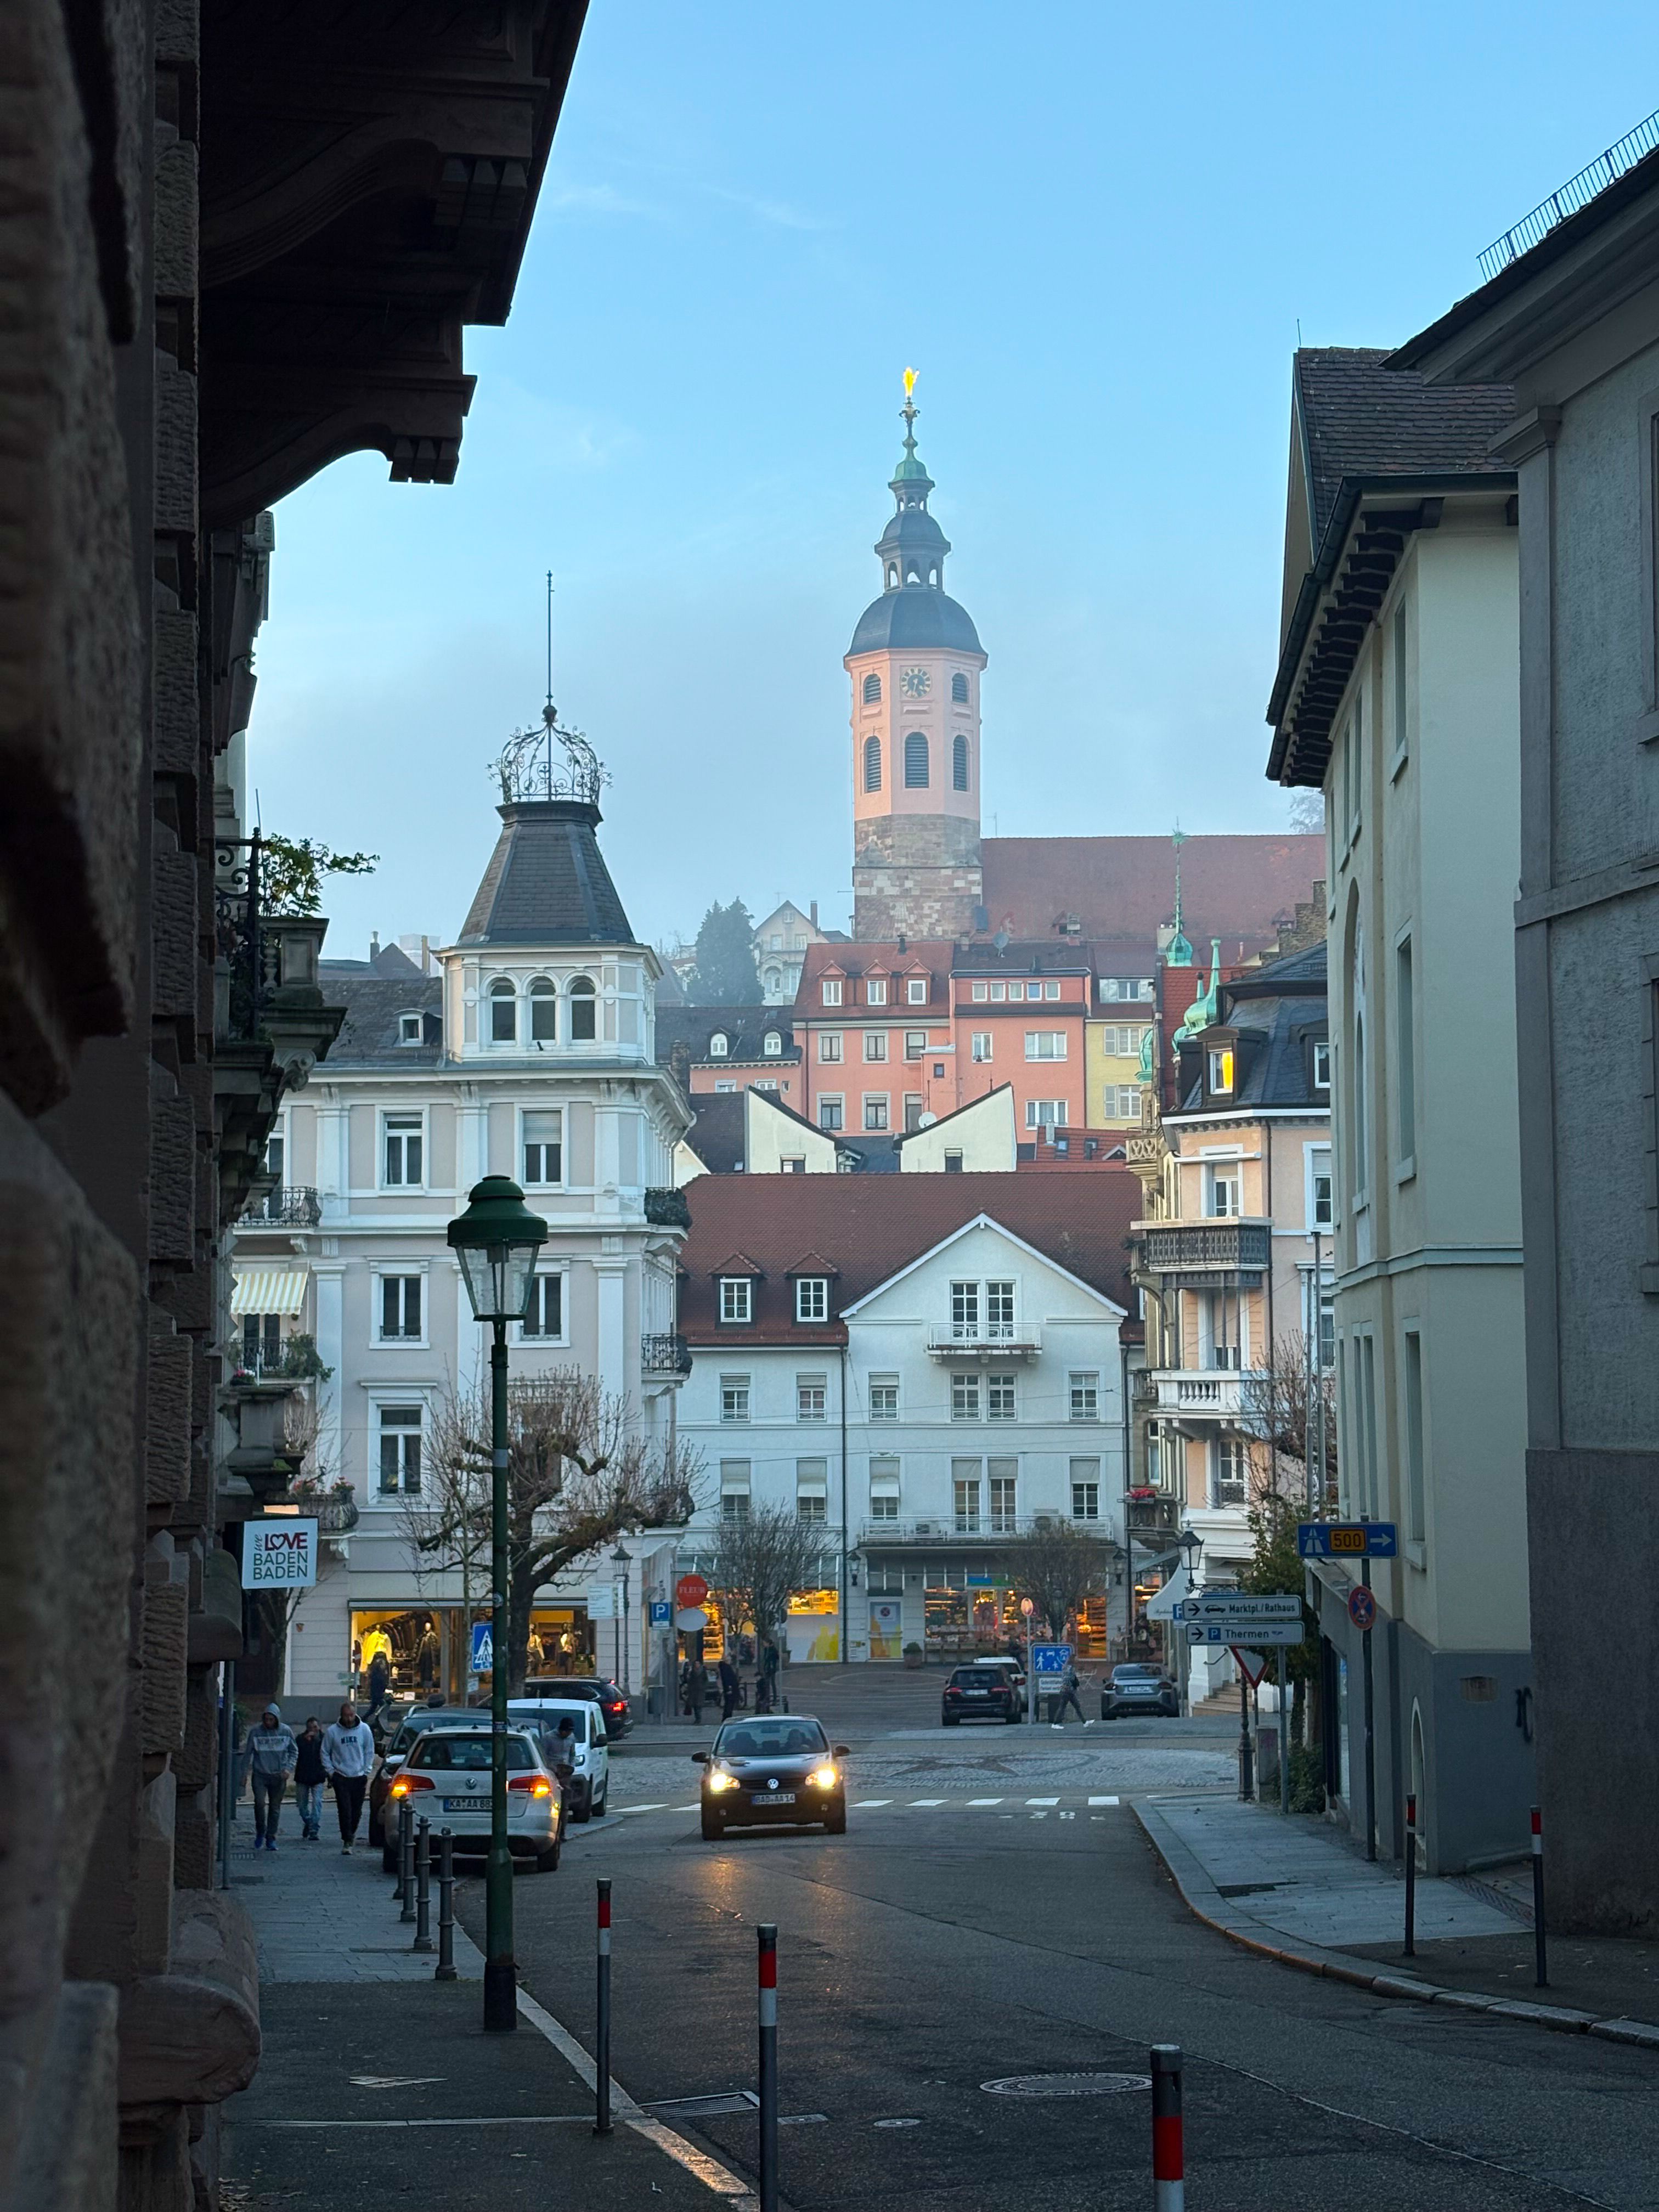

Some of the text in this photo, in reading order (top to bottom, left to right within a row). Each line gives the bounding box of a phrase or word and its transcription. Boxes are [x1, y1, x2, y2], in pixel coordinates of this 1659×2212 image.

[253, 1532, 308, 1552] we LOVE
[1334, 1533, 1361, 1548] 500
[253, 1551, 308, 1566] BADEN
[253, 1564, 308, 1581] BADEN
[657, 1604, 665, 1618] P
[1211, 1629, 1218, 1638] P
[1224, 1629, 1269, 1639] Thermen
